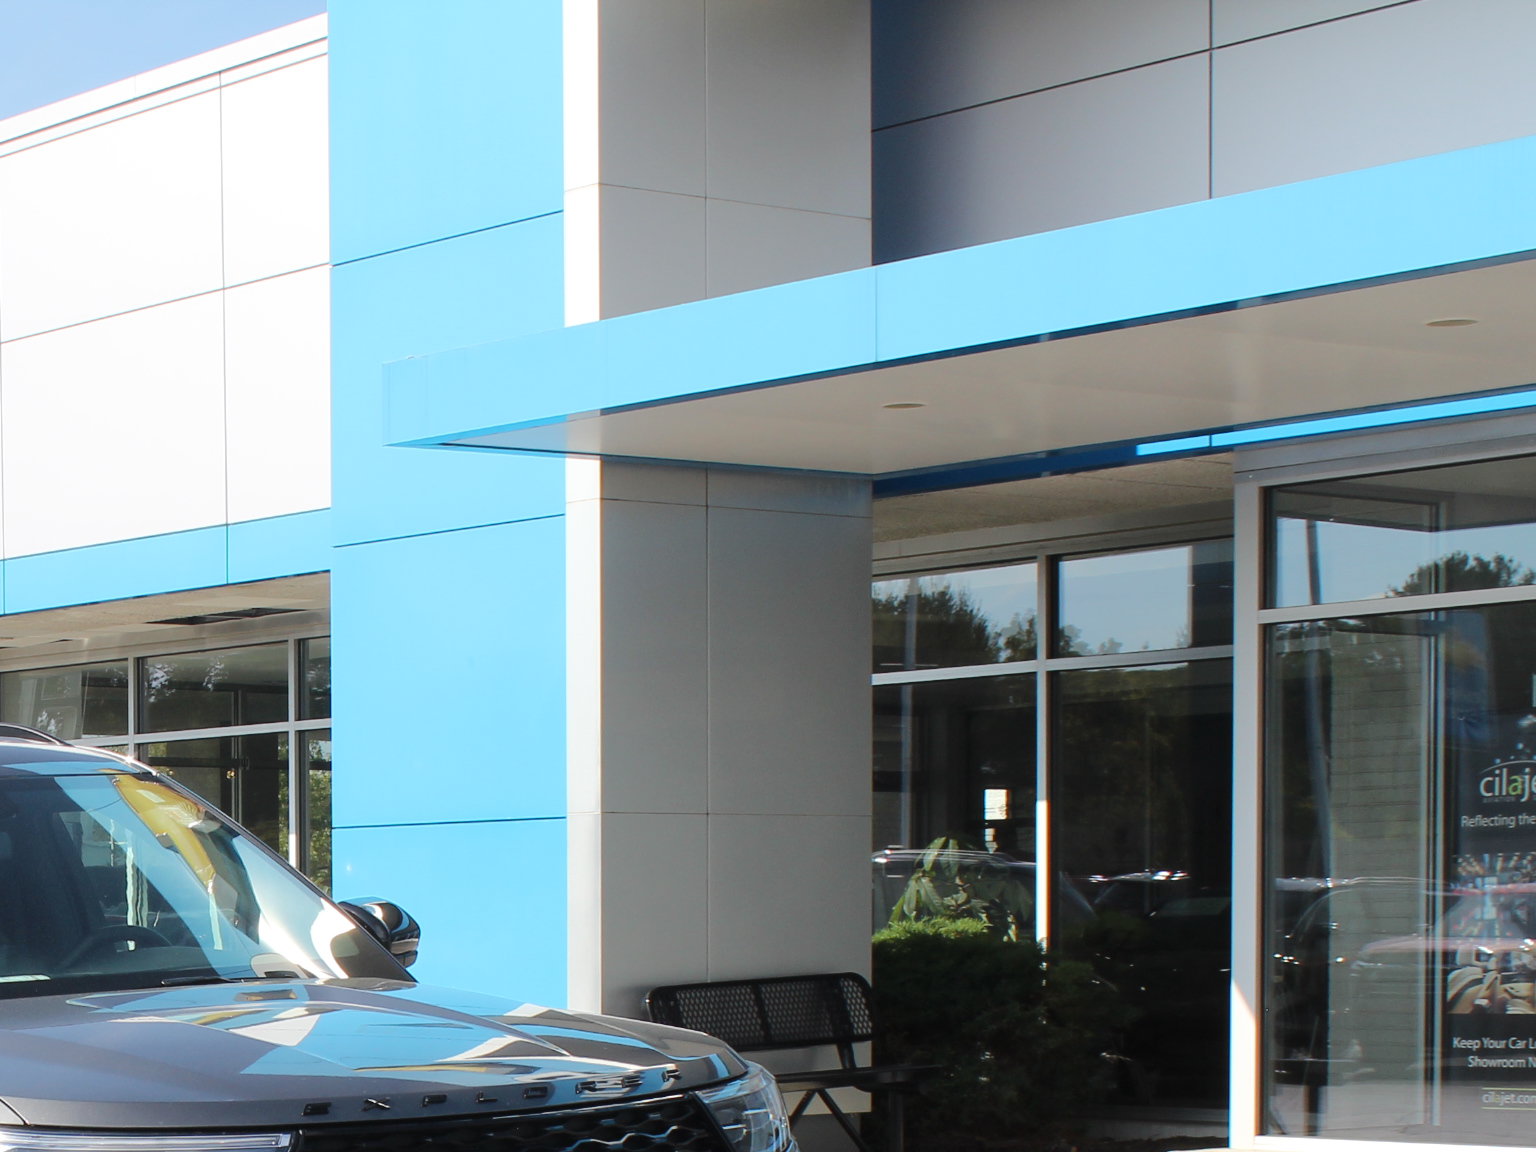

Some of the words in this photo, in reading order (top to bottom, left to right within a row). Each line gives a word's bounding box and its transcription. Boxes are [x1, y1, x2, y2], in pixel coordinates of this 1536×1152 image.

[1460, 814, 1515, 829] Reflecting
[1452, 1036, 1480, 1051] Keep
[1481, 1036, 1506, 1049] Your
[1508, 1037, 1527, 1049] Car
[1528, 1037, 1536, 1050] L
[1467, 1055, 1526, 1068] Showroom
[300, 1068, 682, 1117] EXPLORER
